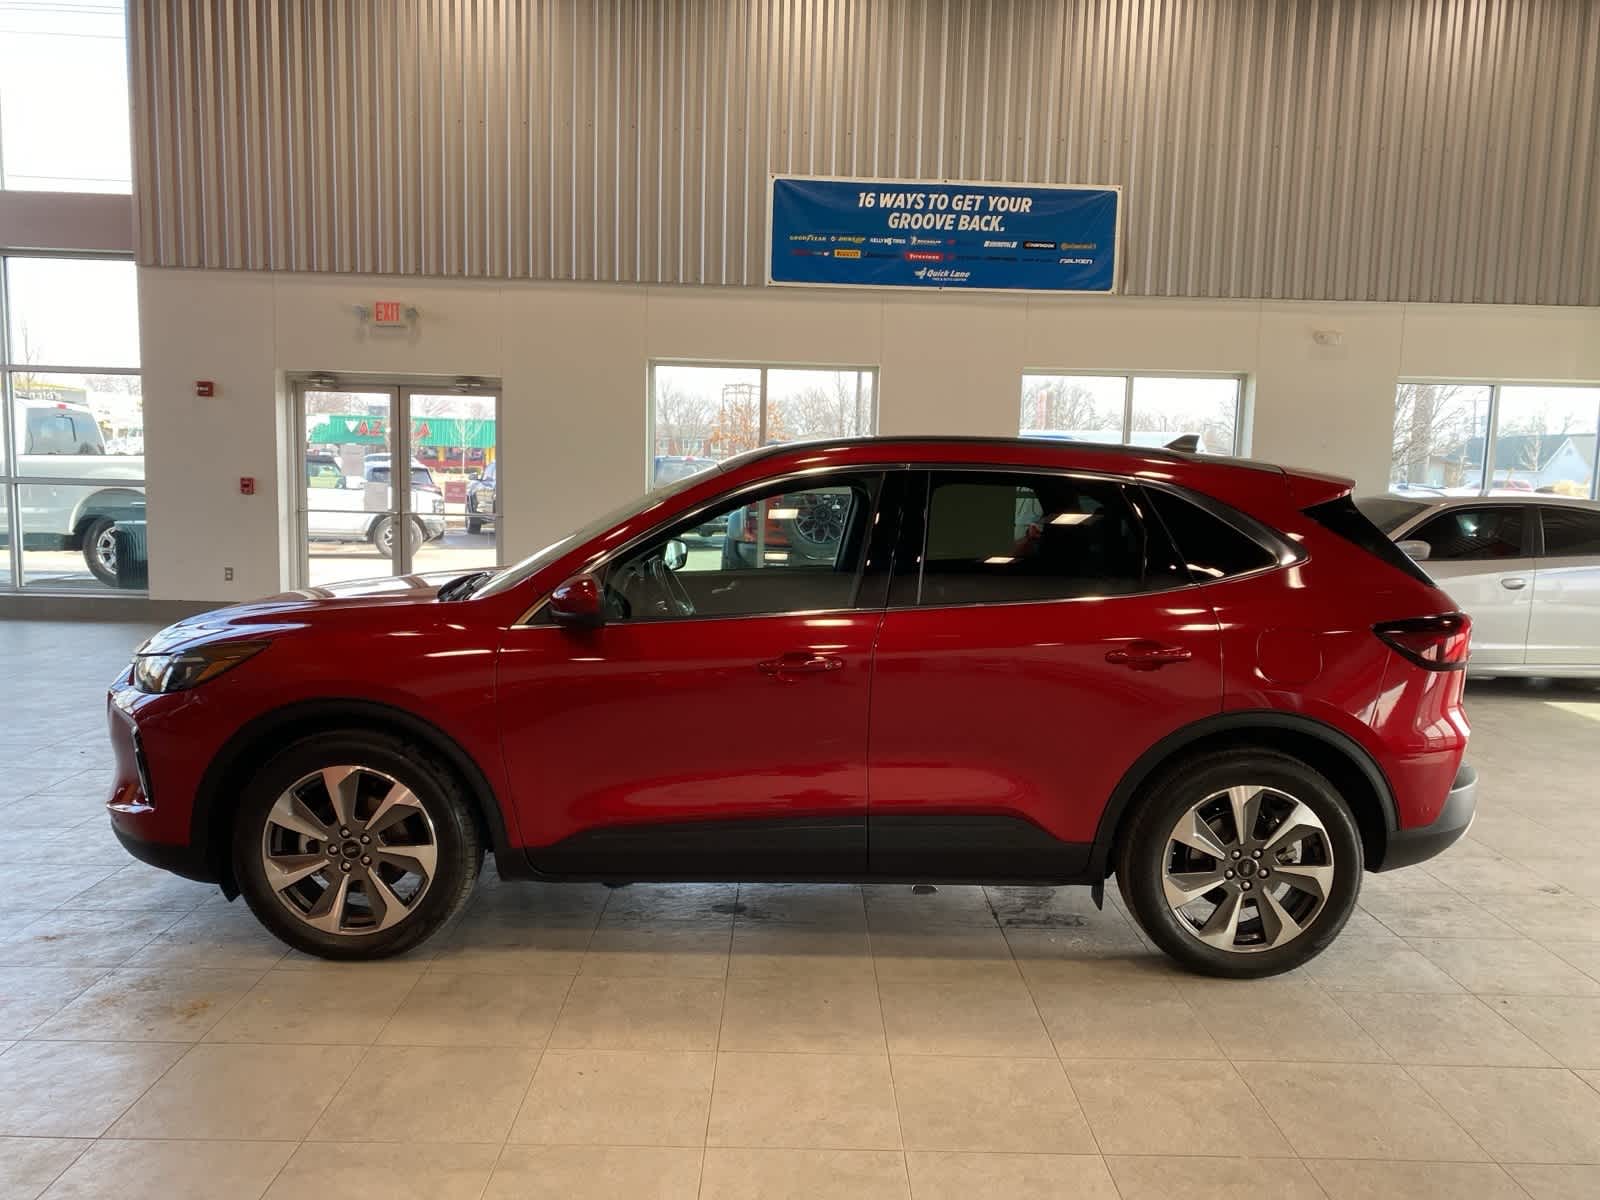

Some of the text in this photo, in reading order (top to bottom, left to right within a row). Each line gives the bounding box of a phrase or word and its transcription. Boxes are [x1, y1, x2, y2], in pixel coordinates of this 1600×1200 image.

[858, 192, 1033, 213] 16 WAYS TO GET YOUR
[888, 212, 1006, 232] GROOVE BACK.
[927, 268, 971, 278] Quick Lane
[375, 302, 400, 321] EXIT
